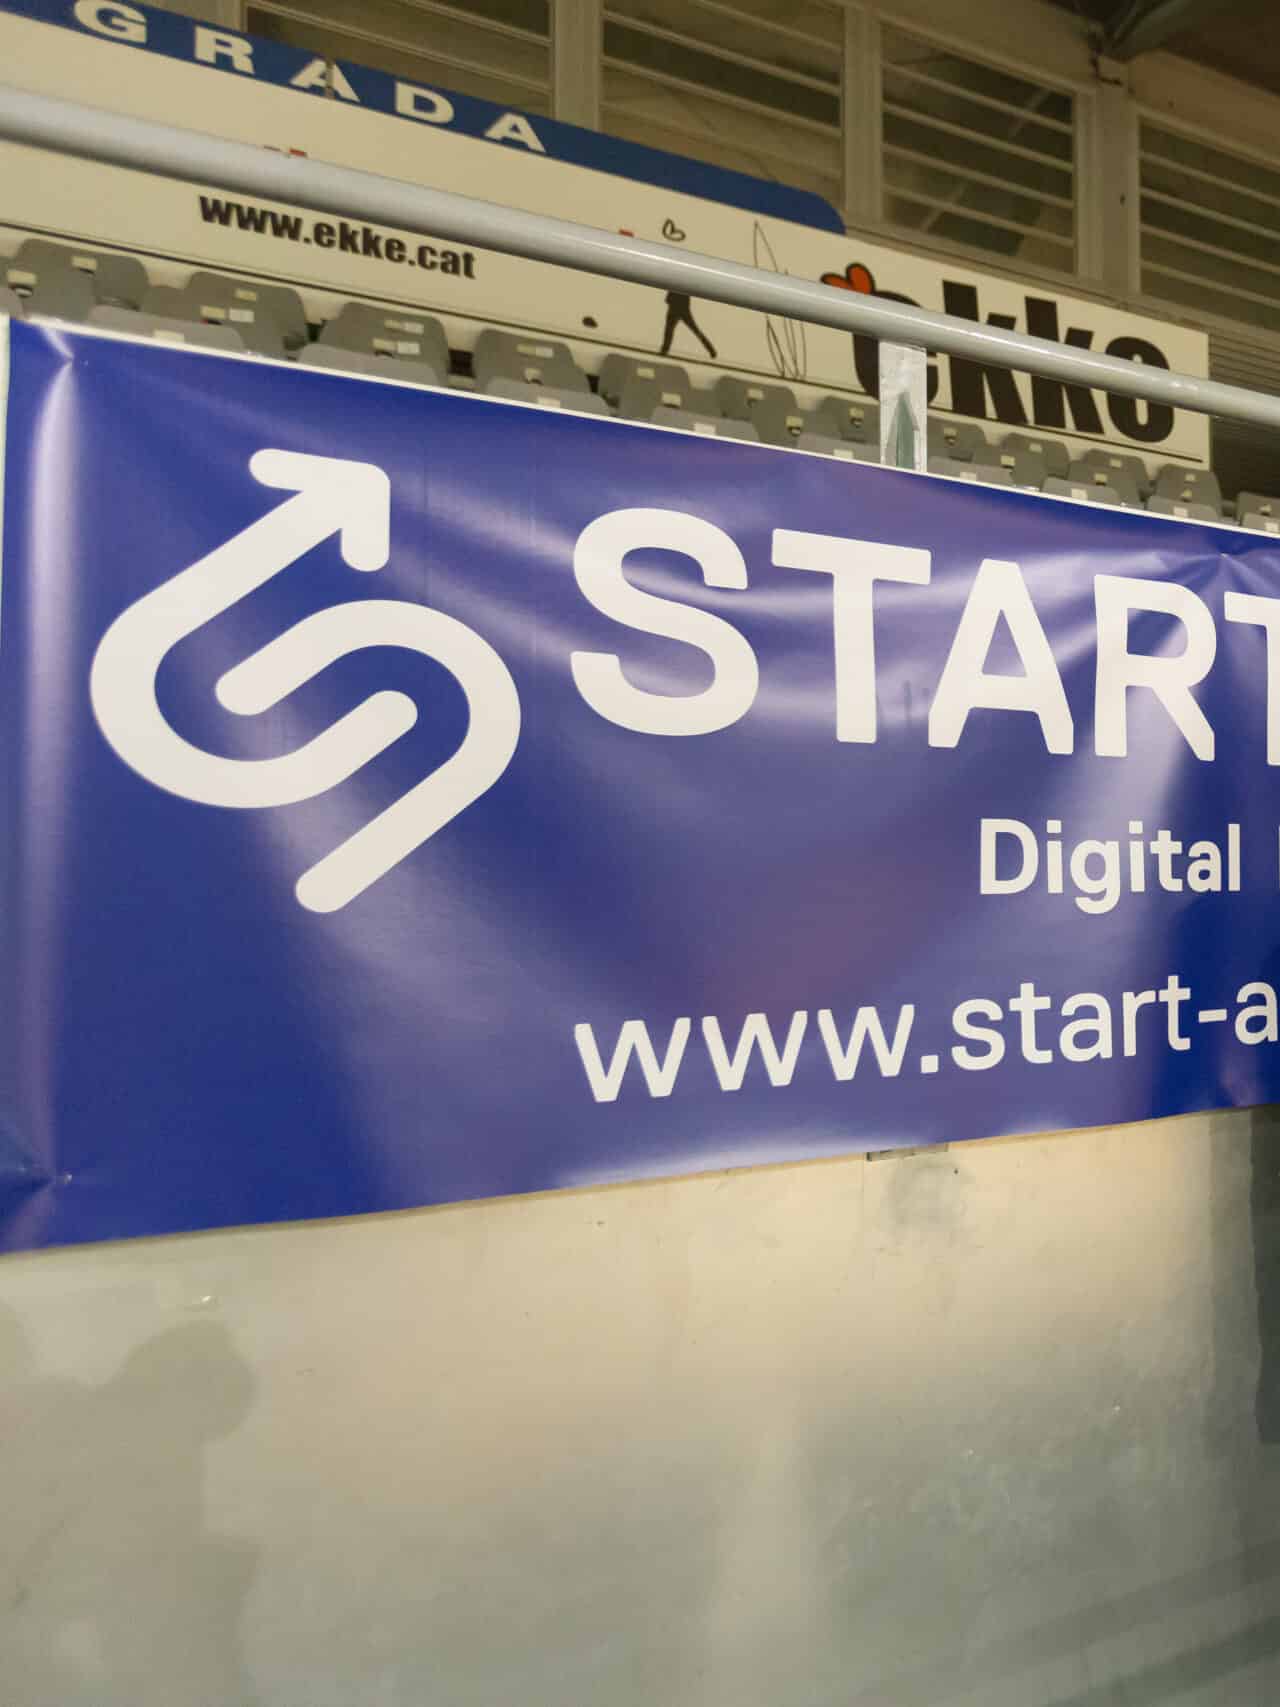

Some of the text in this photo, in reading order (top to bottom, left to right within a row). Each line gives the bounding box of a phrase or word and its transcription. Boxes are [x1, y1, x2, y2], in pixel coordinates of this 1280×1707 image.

[74, 0, 547, 153] GRADA
[199, 197, 476, 280] www.ekke.cat
[979, 816, 1241, 914] Digital
